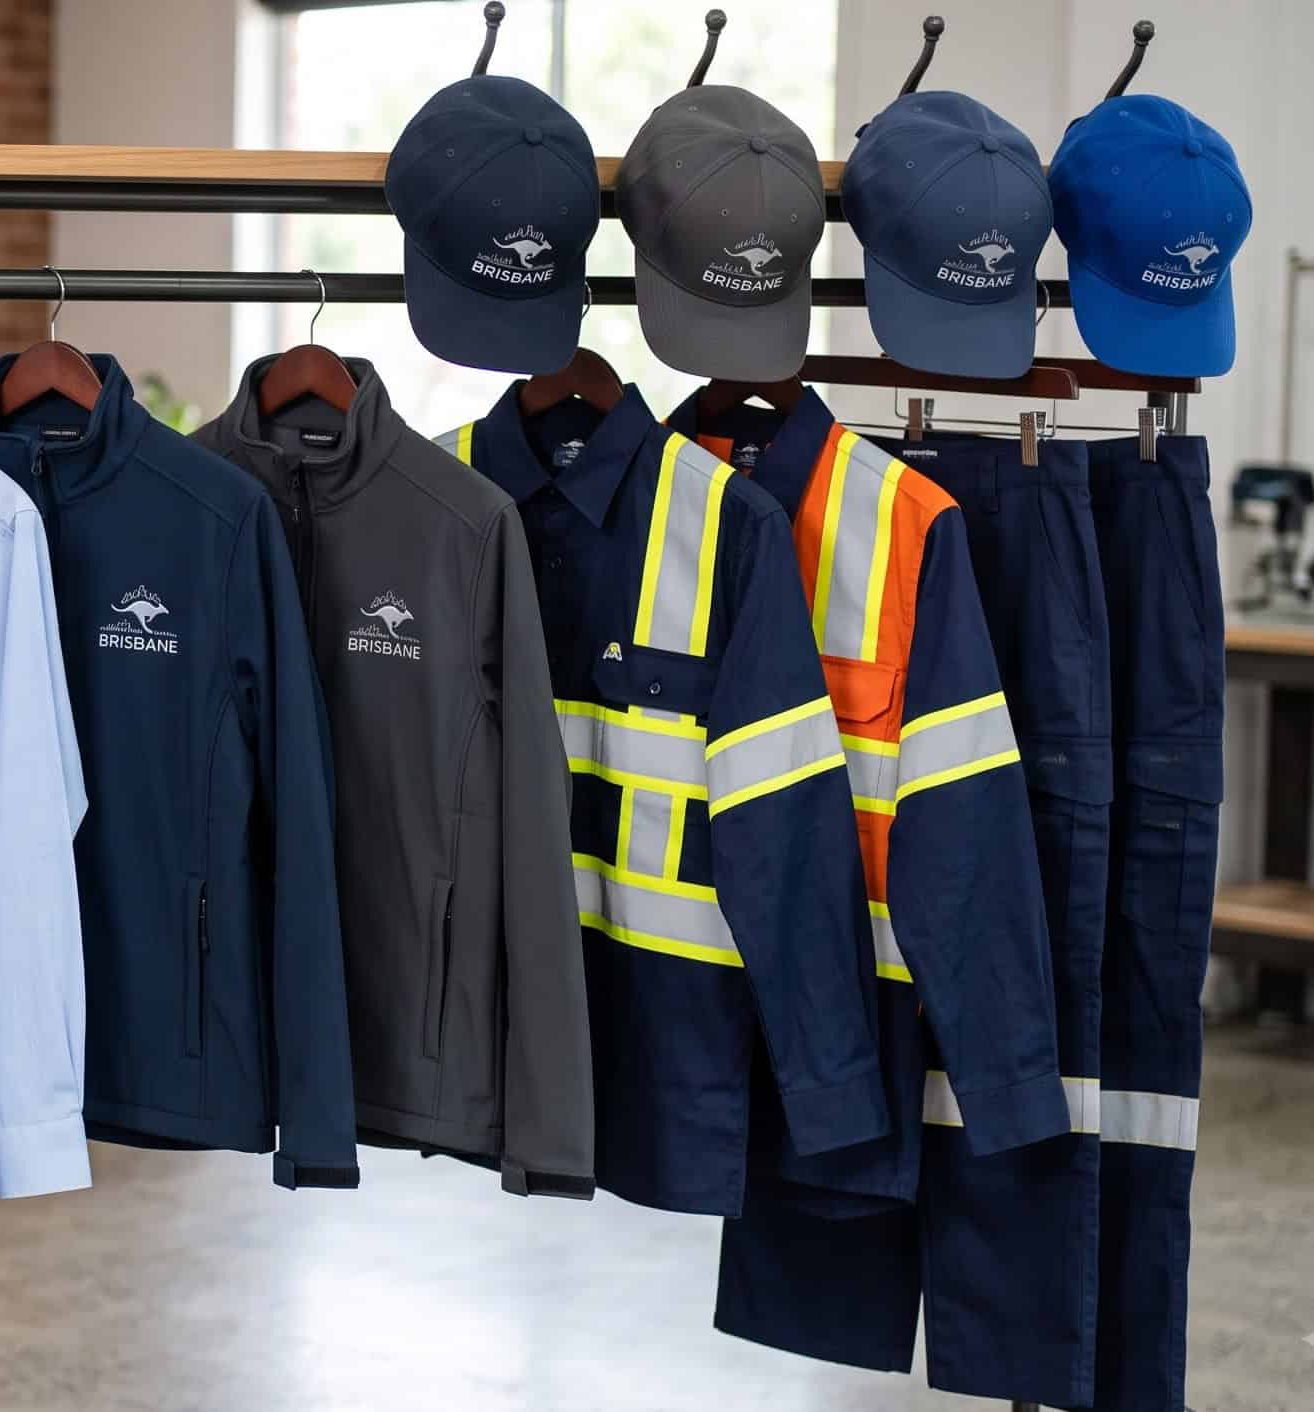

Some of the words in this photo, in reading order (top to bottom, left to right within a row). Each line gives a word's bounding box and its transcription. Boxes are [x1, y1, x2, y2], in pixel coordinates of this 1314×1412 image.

[472, 260, 554, 284] BRISBANE
[702, 269, 783, 291] BRISBANE
[937, 267, 1014, 288] BRISBANE
[1142, 270, 1218, 289] BRISBANE
[99, 633, 178, 654] BRISBANE
[348, 637, 421, 660] BRISBANE
